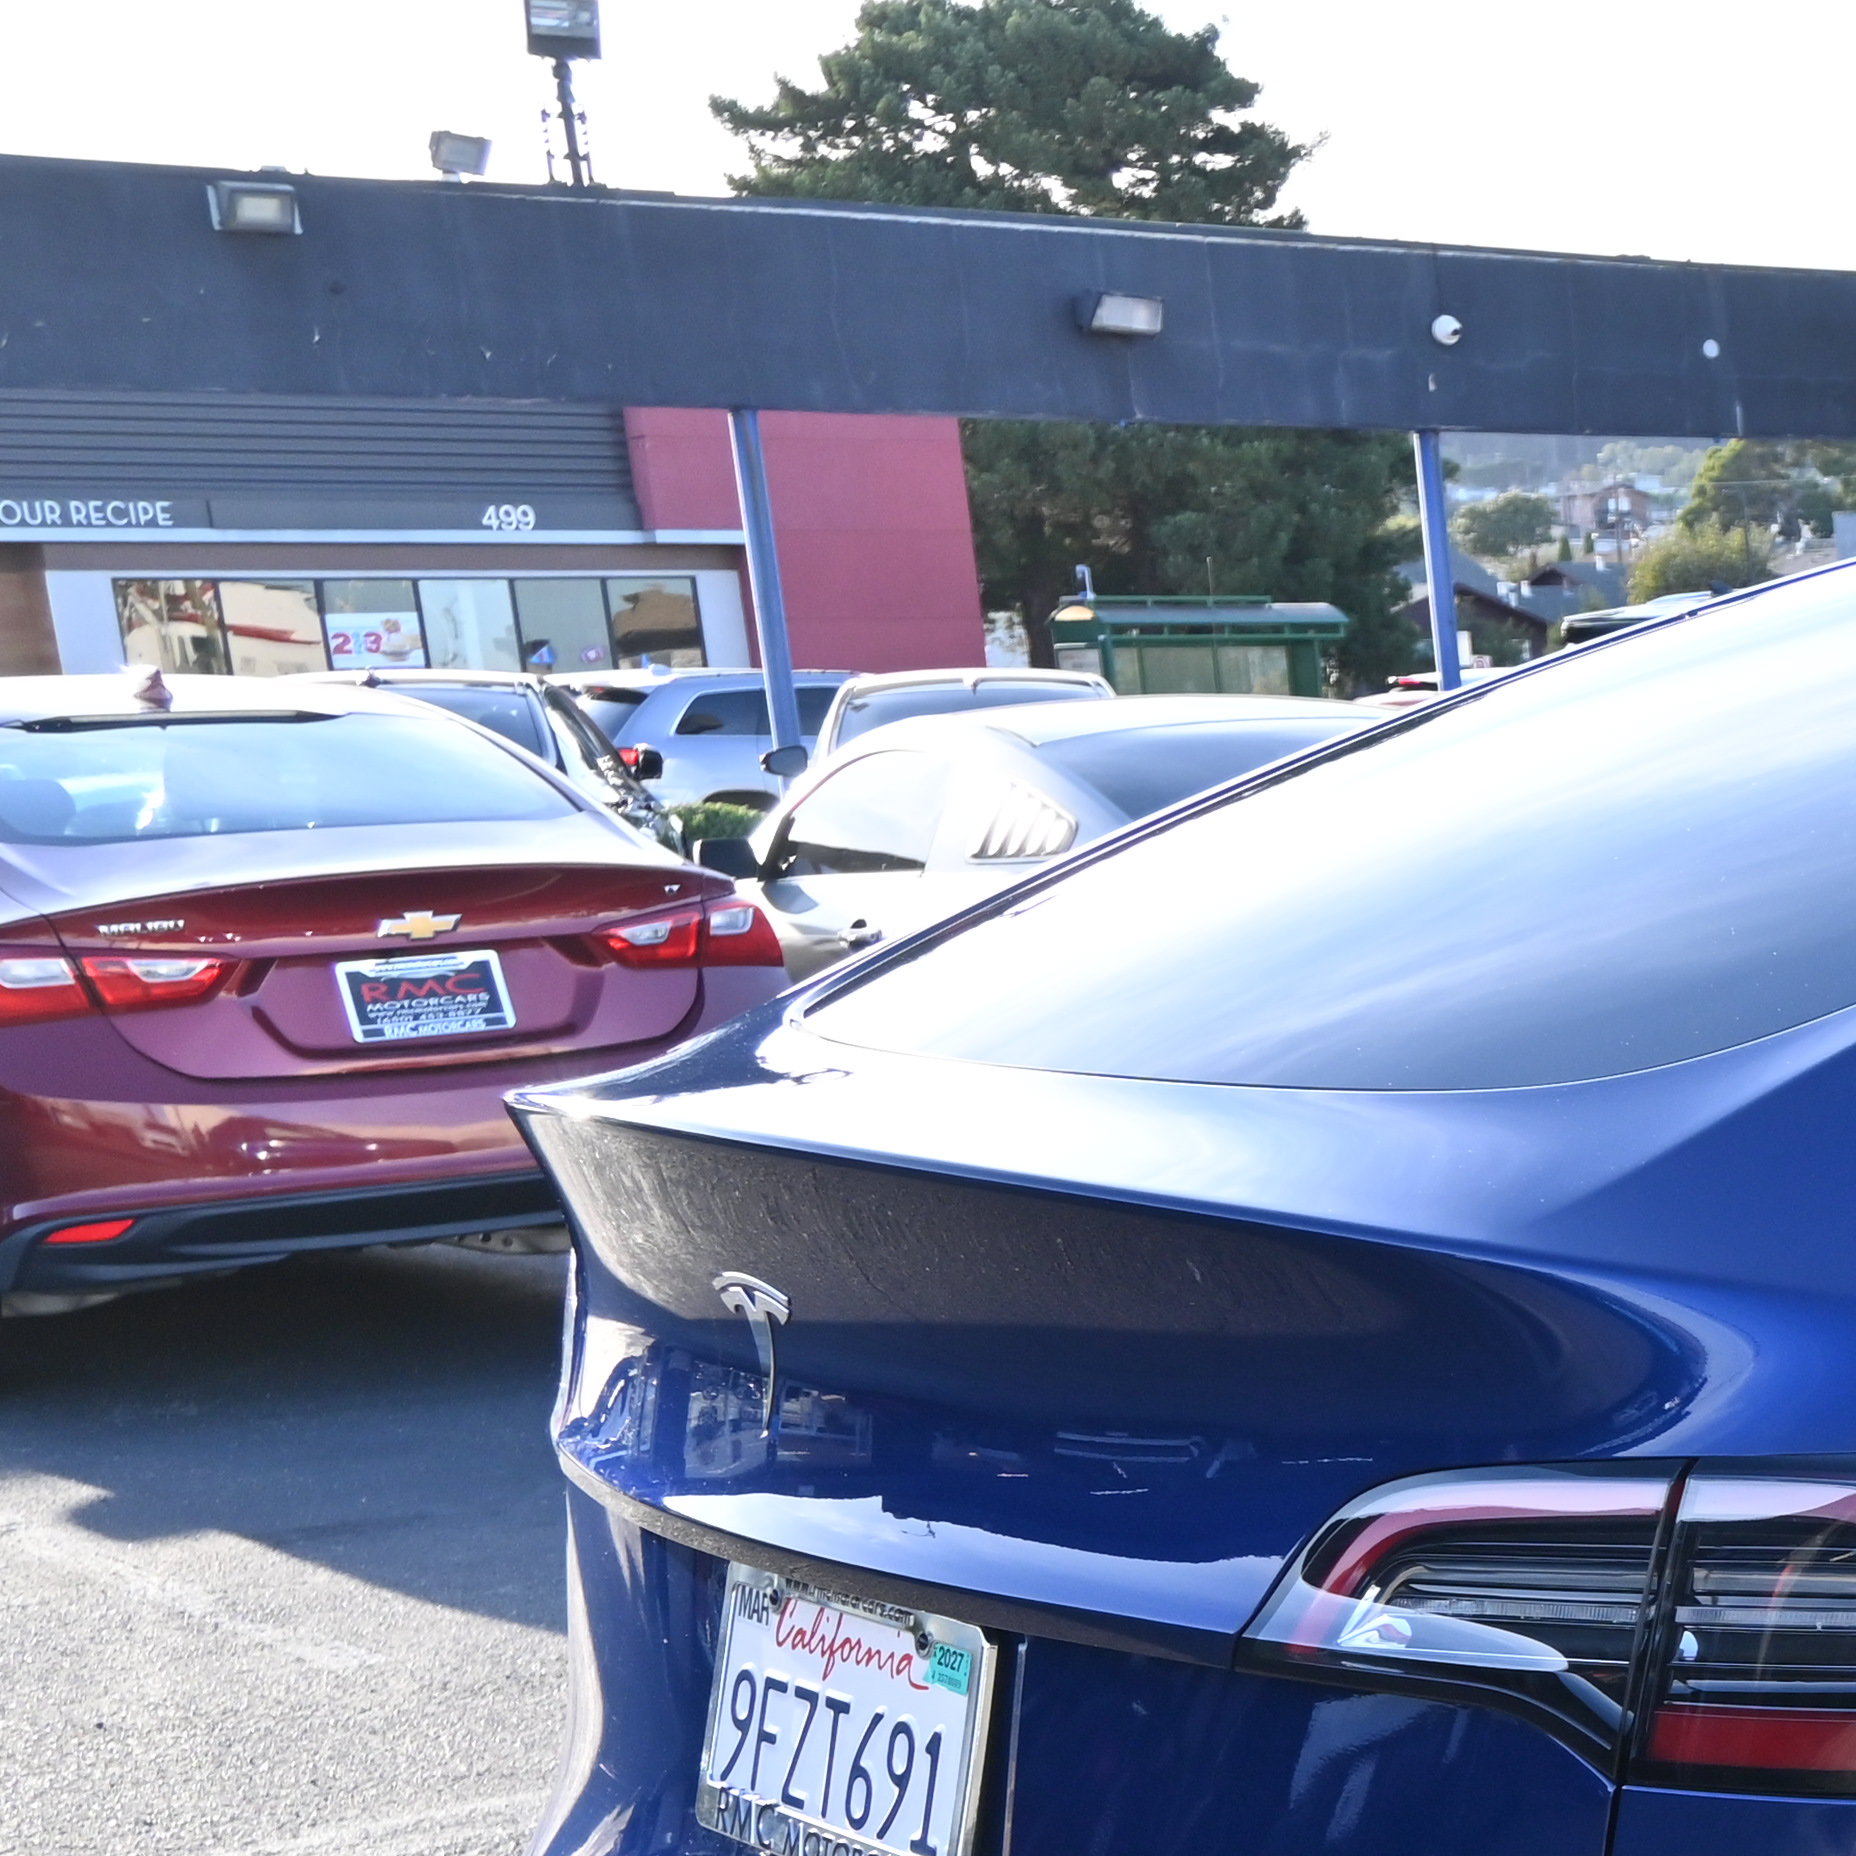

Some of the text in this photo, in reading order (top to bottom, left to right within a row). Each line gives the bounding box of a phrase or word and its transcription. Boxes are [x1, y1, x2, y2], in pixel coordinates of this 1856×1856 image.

[0, 500, 175, 526] OUR RECIPE
[481, 504, 537, 530] 499
[360, 973, 486, 1003] RMC
[366, 992, 490, 1012] MOTORCARS
[384, 1018, 487, 1039] RMC MOTORCARS
[737, 1583, 771, 1626] MAR
[775, 1596, 930, 1690] California
[937, 1645, 965, 1672] 2027
[714, 1786, 778, 1849] RMC
